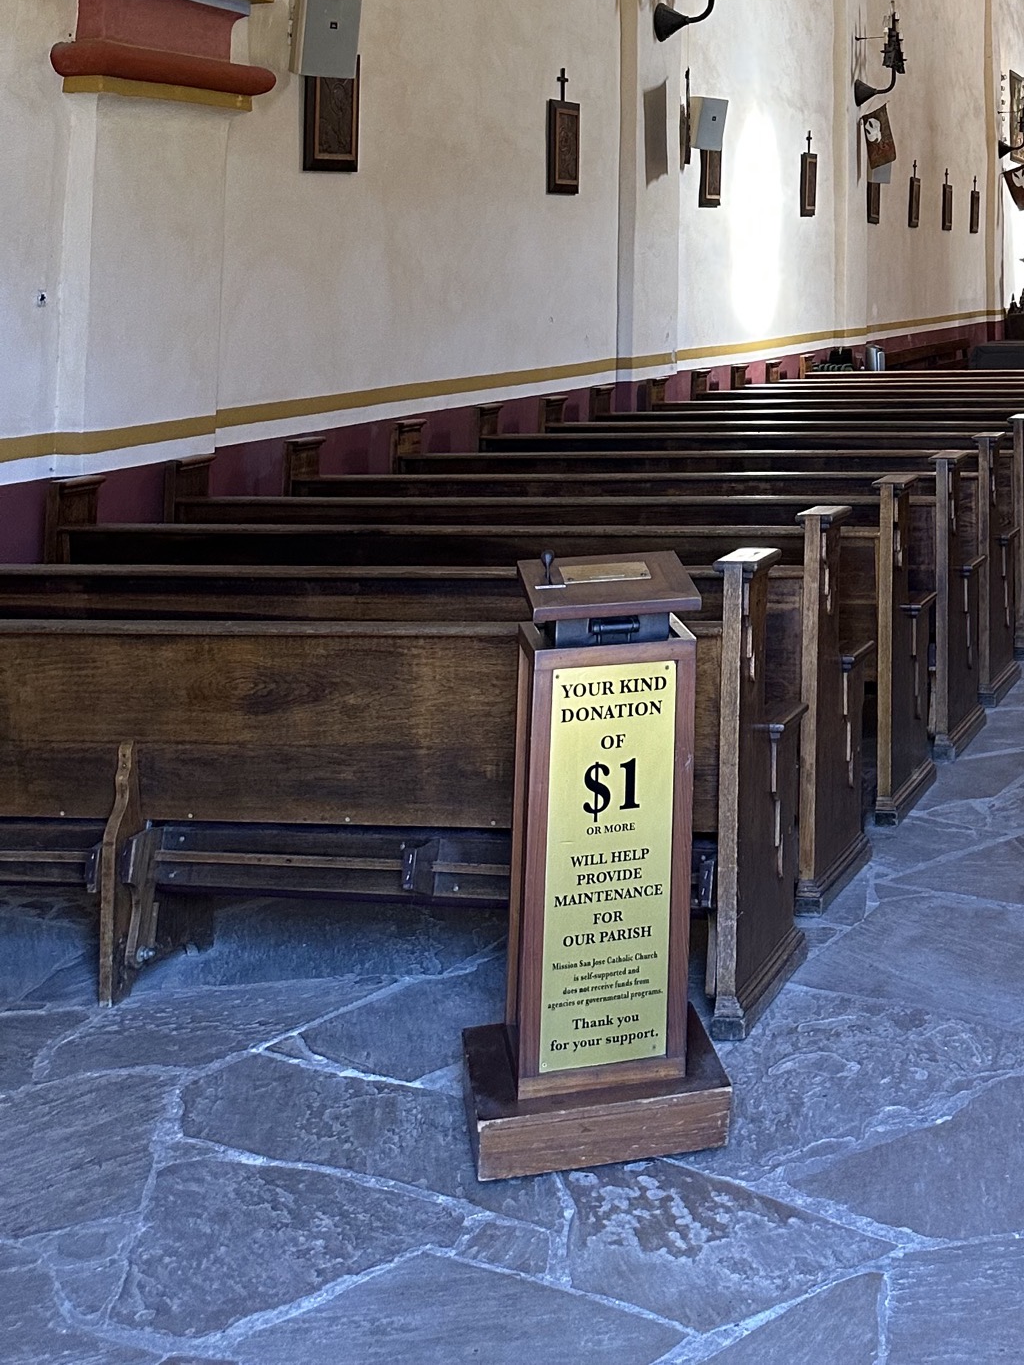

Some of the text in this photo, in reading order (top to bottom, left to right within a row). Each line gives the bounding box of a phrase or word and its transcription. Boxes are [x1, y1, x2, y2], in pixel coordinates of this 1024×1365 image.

[561, 675, 667, 699] YOUR KIND
[560, 700, 663, 724] DONATION
[600, 734, 627, 750] OF
[582, 757, 641, 824] $1
[586, 822, 636, 836] OR MORE
[570, 848, 650, 868] WILL HELP
[576, 867, 643, 886] PROVIDE
[553, 884, 664, 908] MAINTENANCE
[592, 910, 624, 925] FOR
[562, 925, 653, 948] OUR PARISH
[551, 950, 658, 971] Mission San Jose Catholic Church
[573, 966, 640, 982] is self-supported and
[562, 977, 650, 995] does not receive funds from
[547, 999, 576, 1011] agencies
[585, 991, 630, 1007] governmental
[630, 988, 663, 1001] programs.
[572, 1013, 640, 1030] Thank you
[550, 1028, 659, 1053] for your support.
